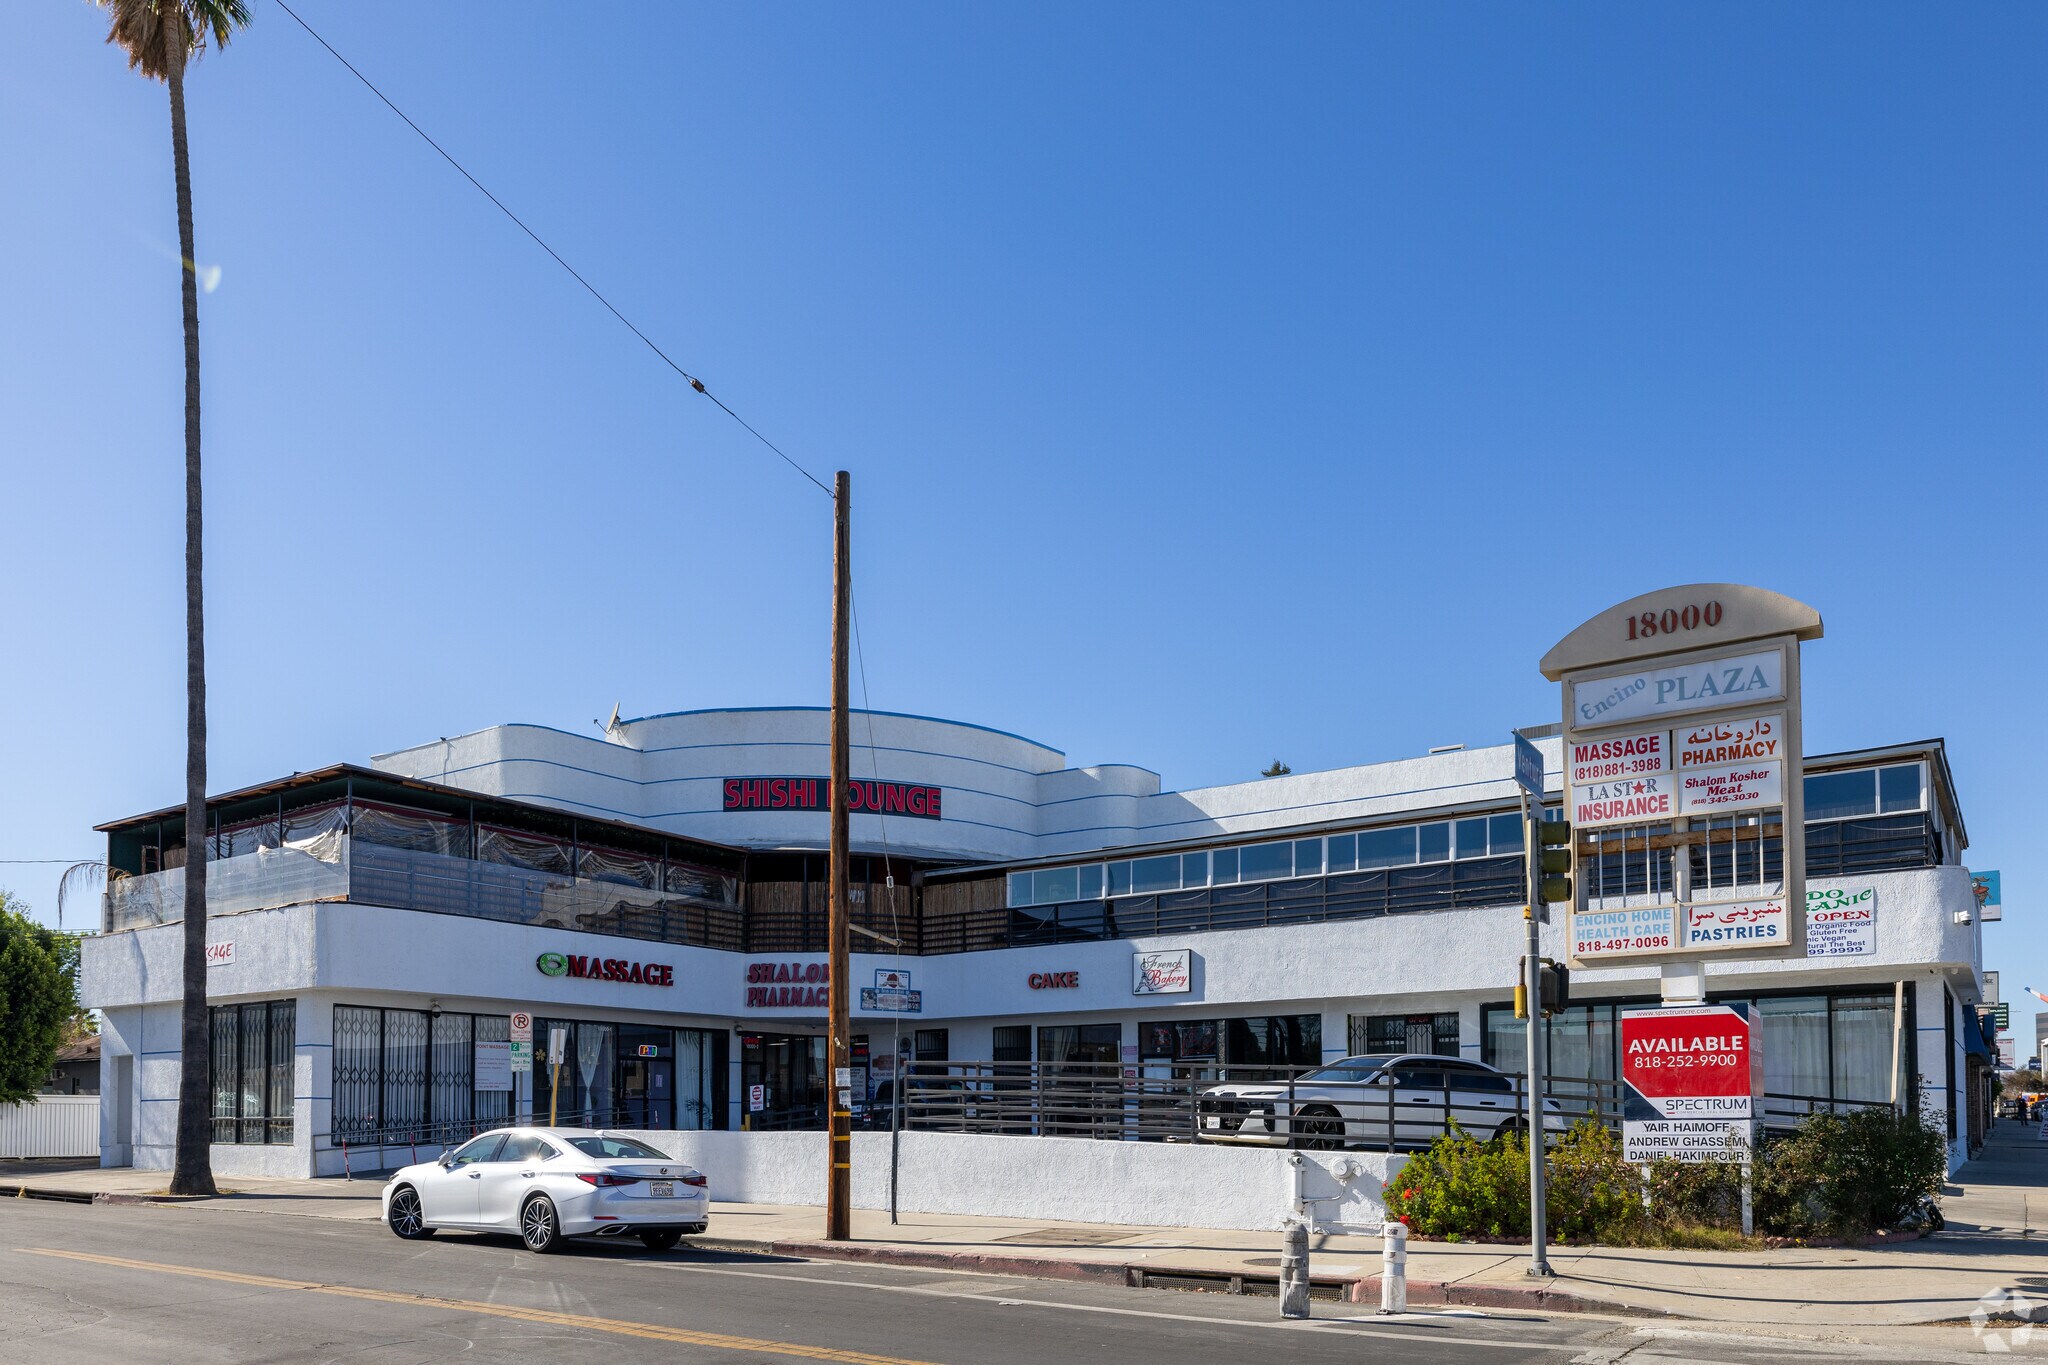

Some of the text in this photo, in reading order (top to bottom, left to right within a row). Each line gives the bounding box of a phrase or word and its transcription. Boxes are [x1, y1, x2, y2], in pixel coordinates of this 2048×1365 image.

[1625, 600, 1722, 641] 18000
[1580, 664, 1770, 720] Encino PLAZA
[1687, 719, 1771, 746] داروخانه
[1575, 735, 1660, 764] MASSAGE
[1682, 739, 1777, 767] PHARMACY
[1517, 744, 1543, 789] Ventura
[1574, 757, 1661, 781] (818)881-3988
[1684, 769, 1770, 789] Shalom Kosher
[724, 779, 817, 808] SHISHI
[1588, 784, 1609, 801] LA
[1706, 783, 1743, 797] Meat
[1708, 791, 1759, 805] 345-3030
[1578, 794, 1669, 823] INSURANCE
[1576, 909, 1672, 927] ENCINO HOME
[1814, 910, 1871, 922] OPEN
[1577, 923, 1670, 940] HEALTH CARE
[1691, 925, 1777, 942] PASTRIES
[1810, 929, 1837, 937] Gluten
[1814, 923, 1847, 931] Organic
[1578, 936, 1669, 952] 818-497-0096
[1821, 935, 1846, 943] Vegan
[566, 954, 673, 987] MASSAGE
[1141, 954, 1184, 971] French
[1028, 971, 1079, 990] CAKE
[1145, 969, 1187, 988] Bakery
[1636, 1007, 1711, 1017] www.spectrumcre.com
[1628, 1035, 1743, 1054] AVAILABLE
[1635, 1054, 1737, 1068] 818-252-9900
[1666, 1098, 1747, 1111] SPECTRUM
[1644, 1122, 1730, 1132] YAIR HAIMOFF
[1628, 1136, 1746, 1147] ANDREW GHASSEMI
[1630, 1151, 1745, 1161] DANIEL HAKIMPOUR
